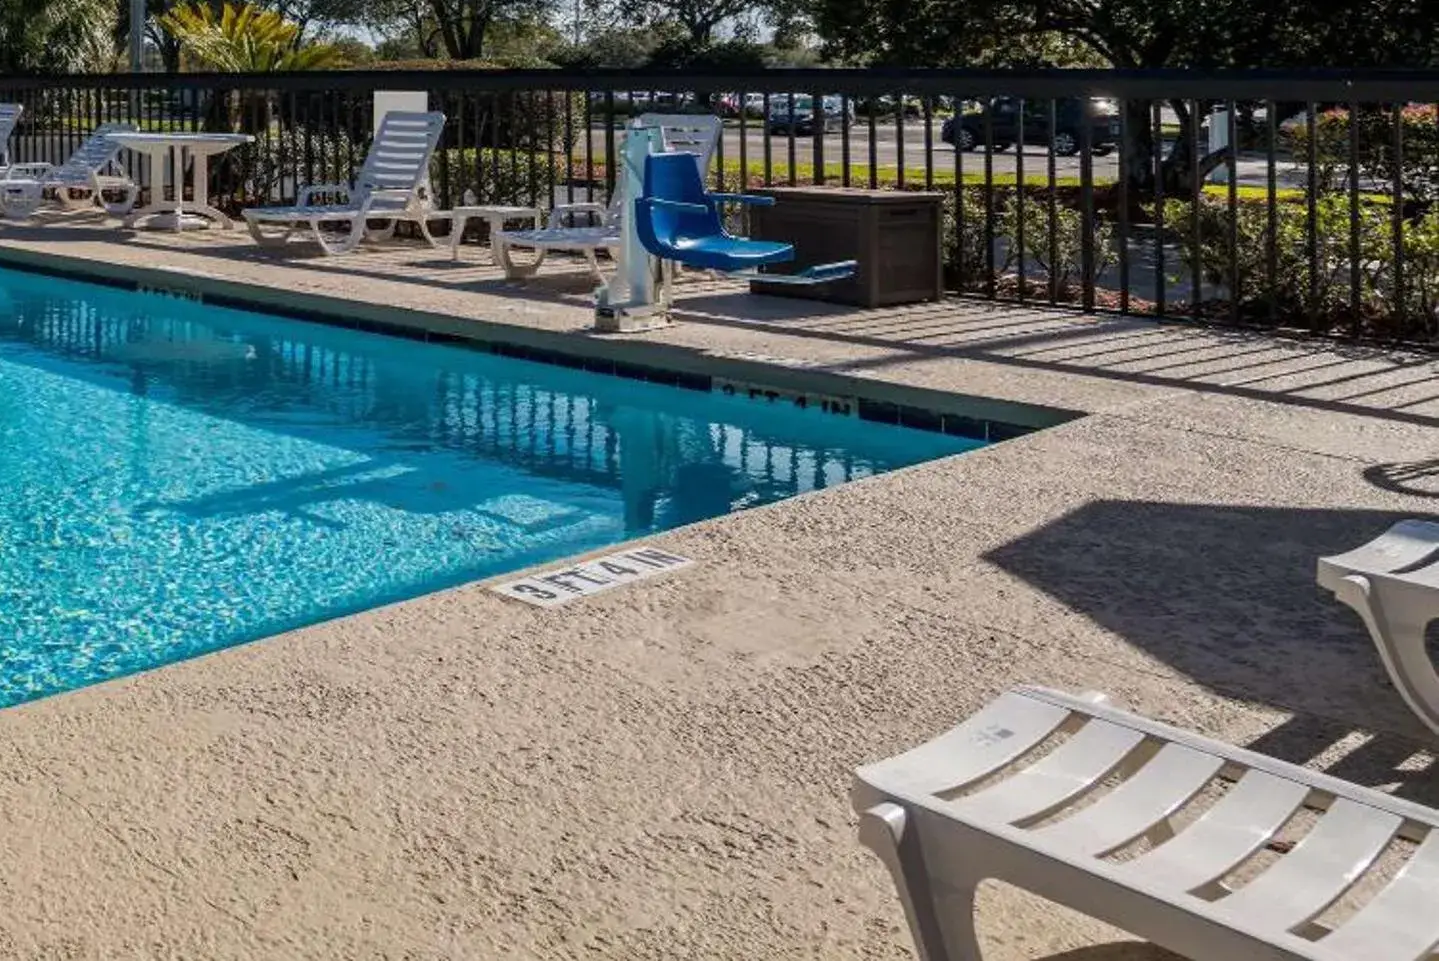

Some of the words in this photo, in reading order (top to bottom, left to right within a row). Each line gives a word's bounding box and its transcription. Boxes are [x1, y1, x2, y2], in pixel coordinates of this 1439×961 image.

[512, 583, 557, 599] 3
[539, 567, 611, 594] FT
[599, 560, 639, 575] 4
[624, 549, 686, 569] IN
